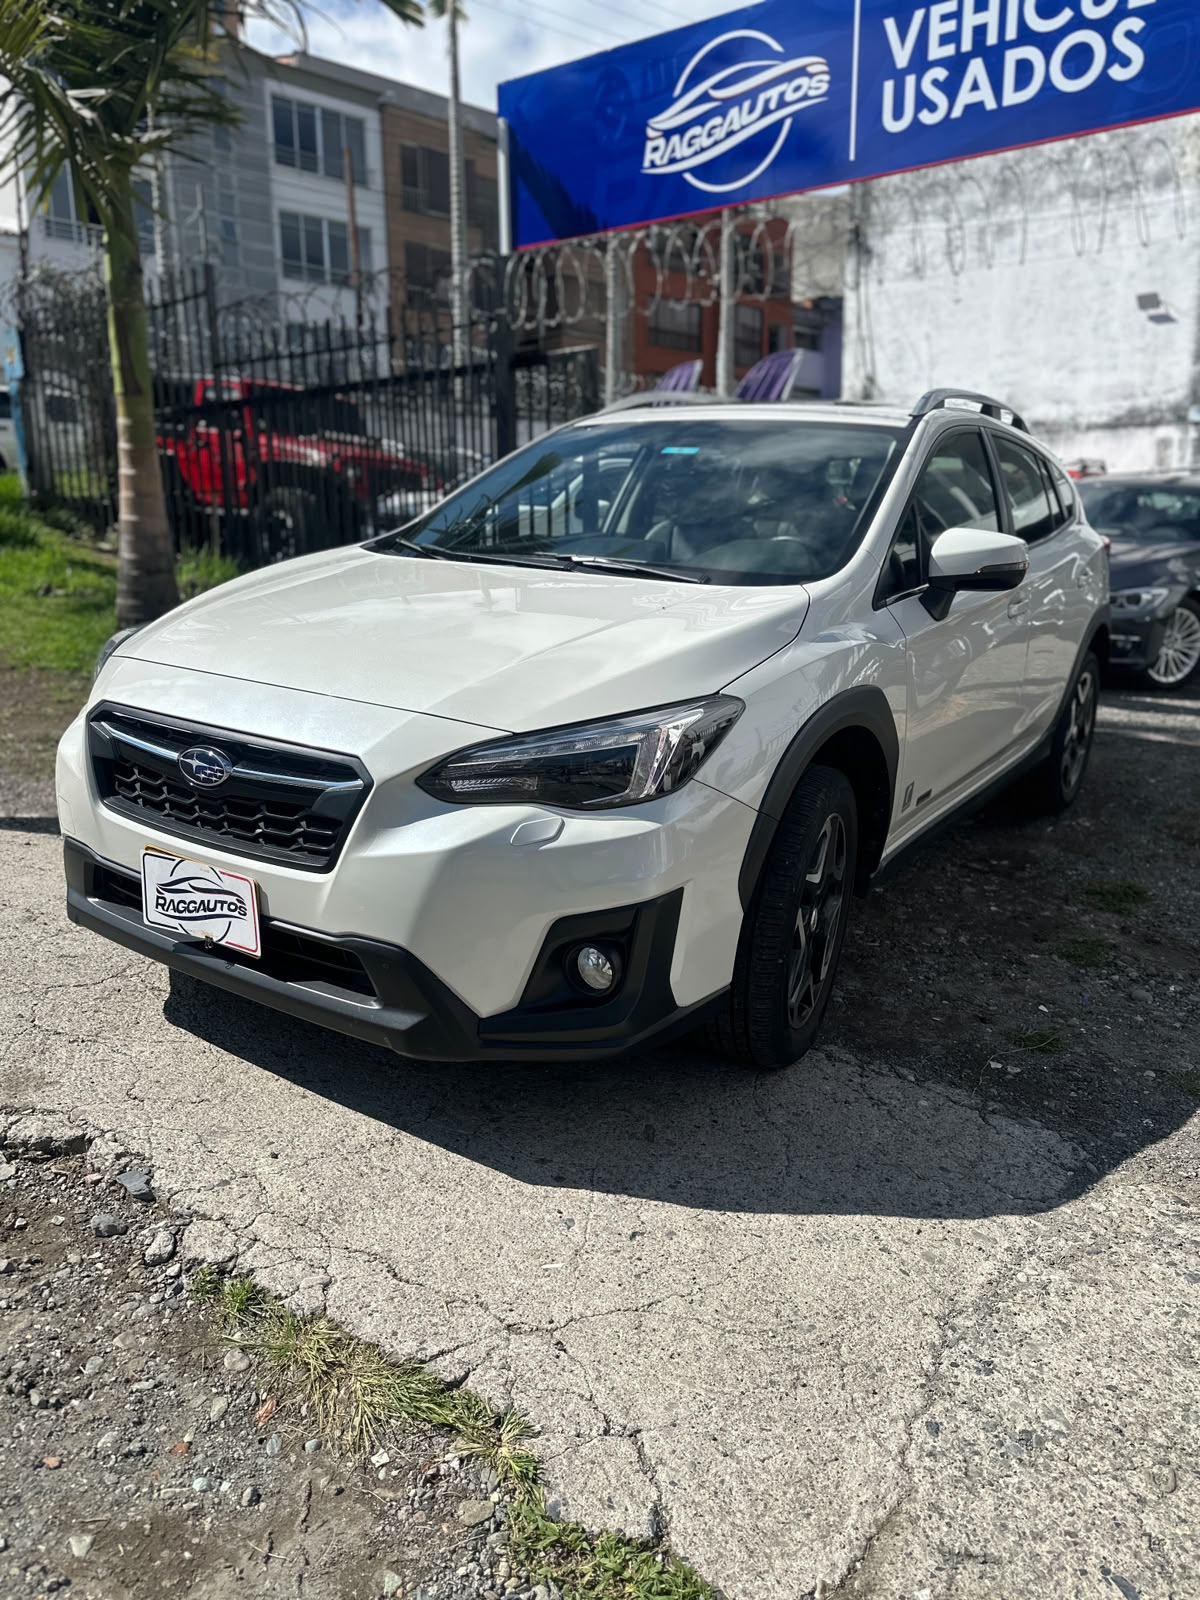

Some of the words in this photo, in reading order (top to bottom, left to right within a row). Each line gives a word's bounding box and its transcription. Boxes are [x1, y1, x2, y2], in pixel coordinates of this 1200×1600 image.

[881, 16, 1147, 134] USADOS
[883, 0, 1158, 69] VEHIC
[642, 73, 831, 169] RAGGAUTOS
[154, 894, 248, 917] RAGGAUTOS
